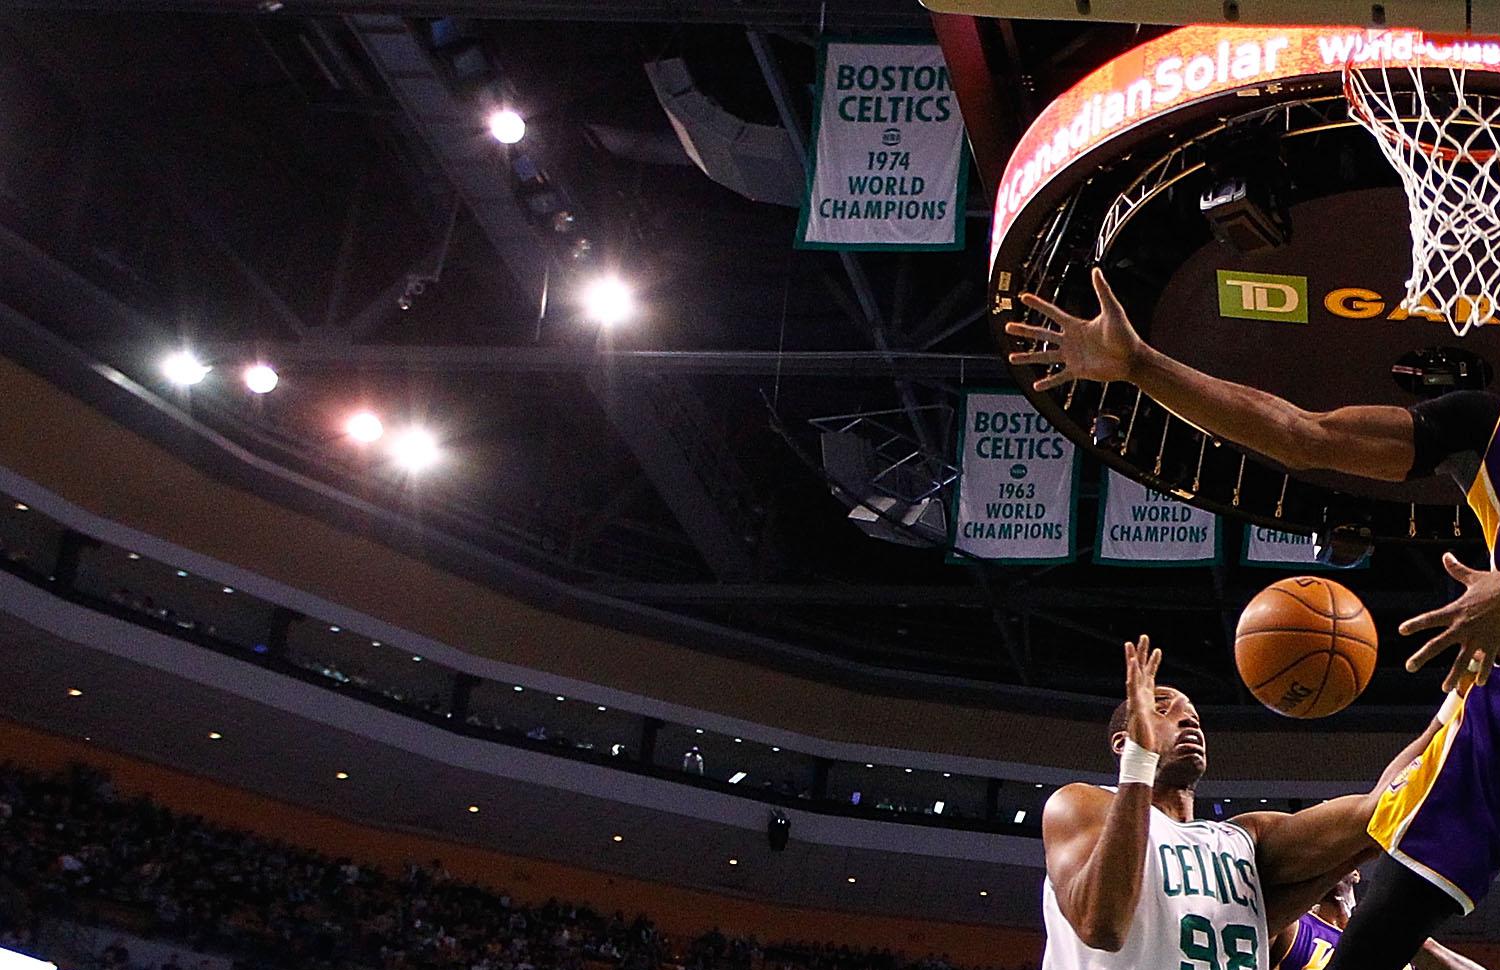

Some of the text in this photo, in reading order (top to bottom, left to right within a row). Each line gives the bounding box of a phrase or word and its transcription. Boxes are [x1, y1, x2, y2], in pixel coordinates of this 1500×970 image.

[838, 96, 951, 123] CELTICS
[1007, 37, 1288, 213] CanadianSolar
[868, 152, 910, 171] 1974
[849, 176, 924, 196] WORLD
[819, 198, 947, 220] CHAMPIONS
[1226, 280, 1299, 313] TD
[974, 411, 1055, 433] BOSTO
[976, 436, 1064, 460] CELTICS
[999, 483, 1035, 499] 1963
[986, 503, 1045, 520] WORLD
[1132, 505, 1191, 522] WORLD
[964, 521, 1063, 540] CHAMPIONS
[1110, 524, 1208, 543] CHAMPIONS
